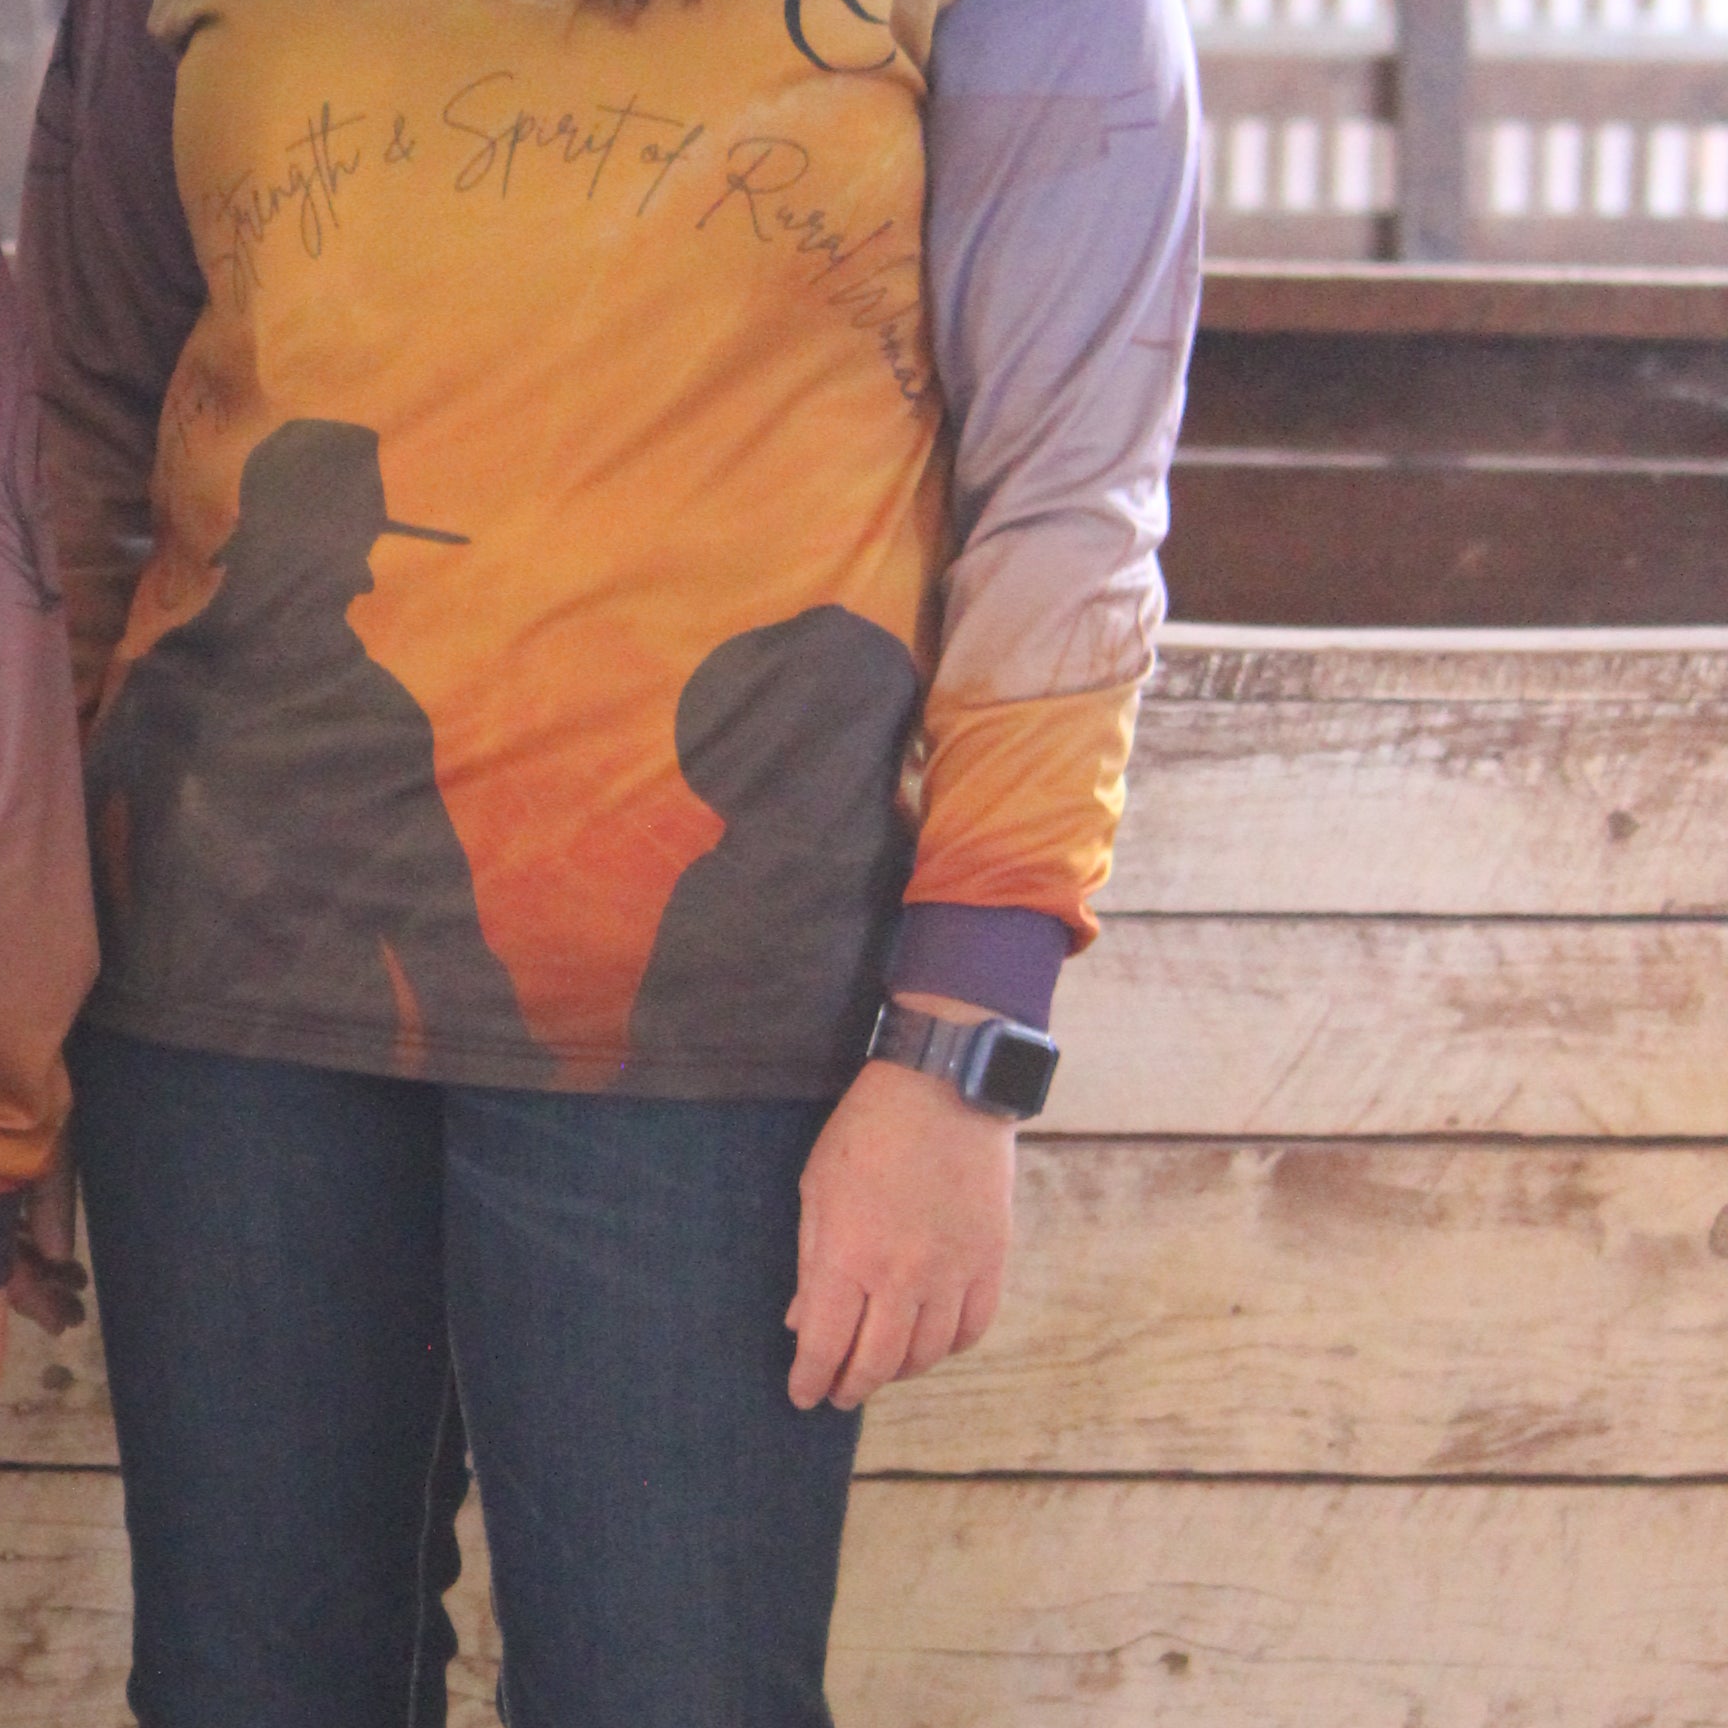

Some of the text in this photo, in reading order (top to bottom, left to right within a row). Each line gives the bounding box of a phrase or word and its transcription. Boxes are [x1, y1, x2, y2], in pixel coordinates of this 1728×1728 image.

[383, 113, 416, 165] &
[442, 70, 685, 201] Spirit
[639, 123, 705, 218] of
[694, 135, 894, 287] Rural
